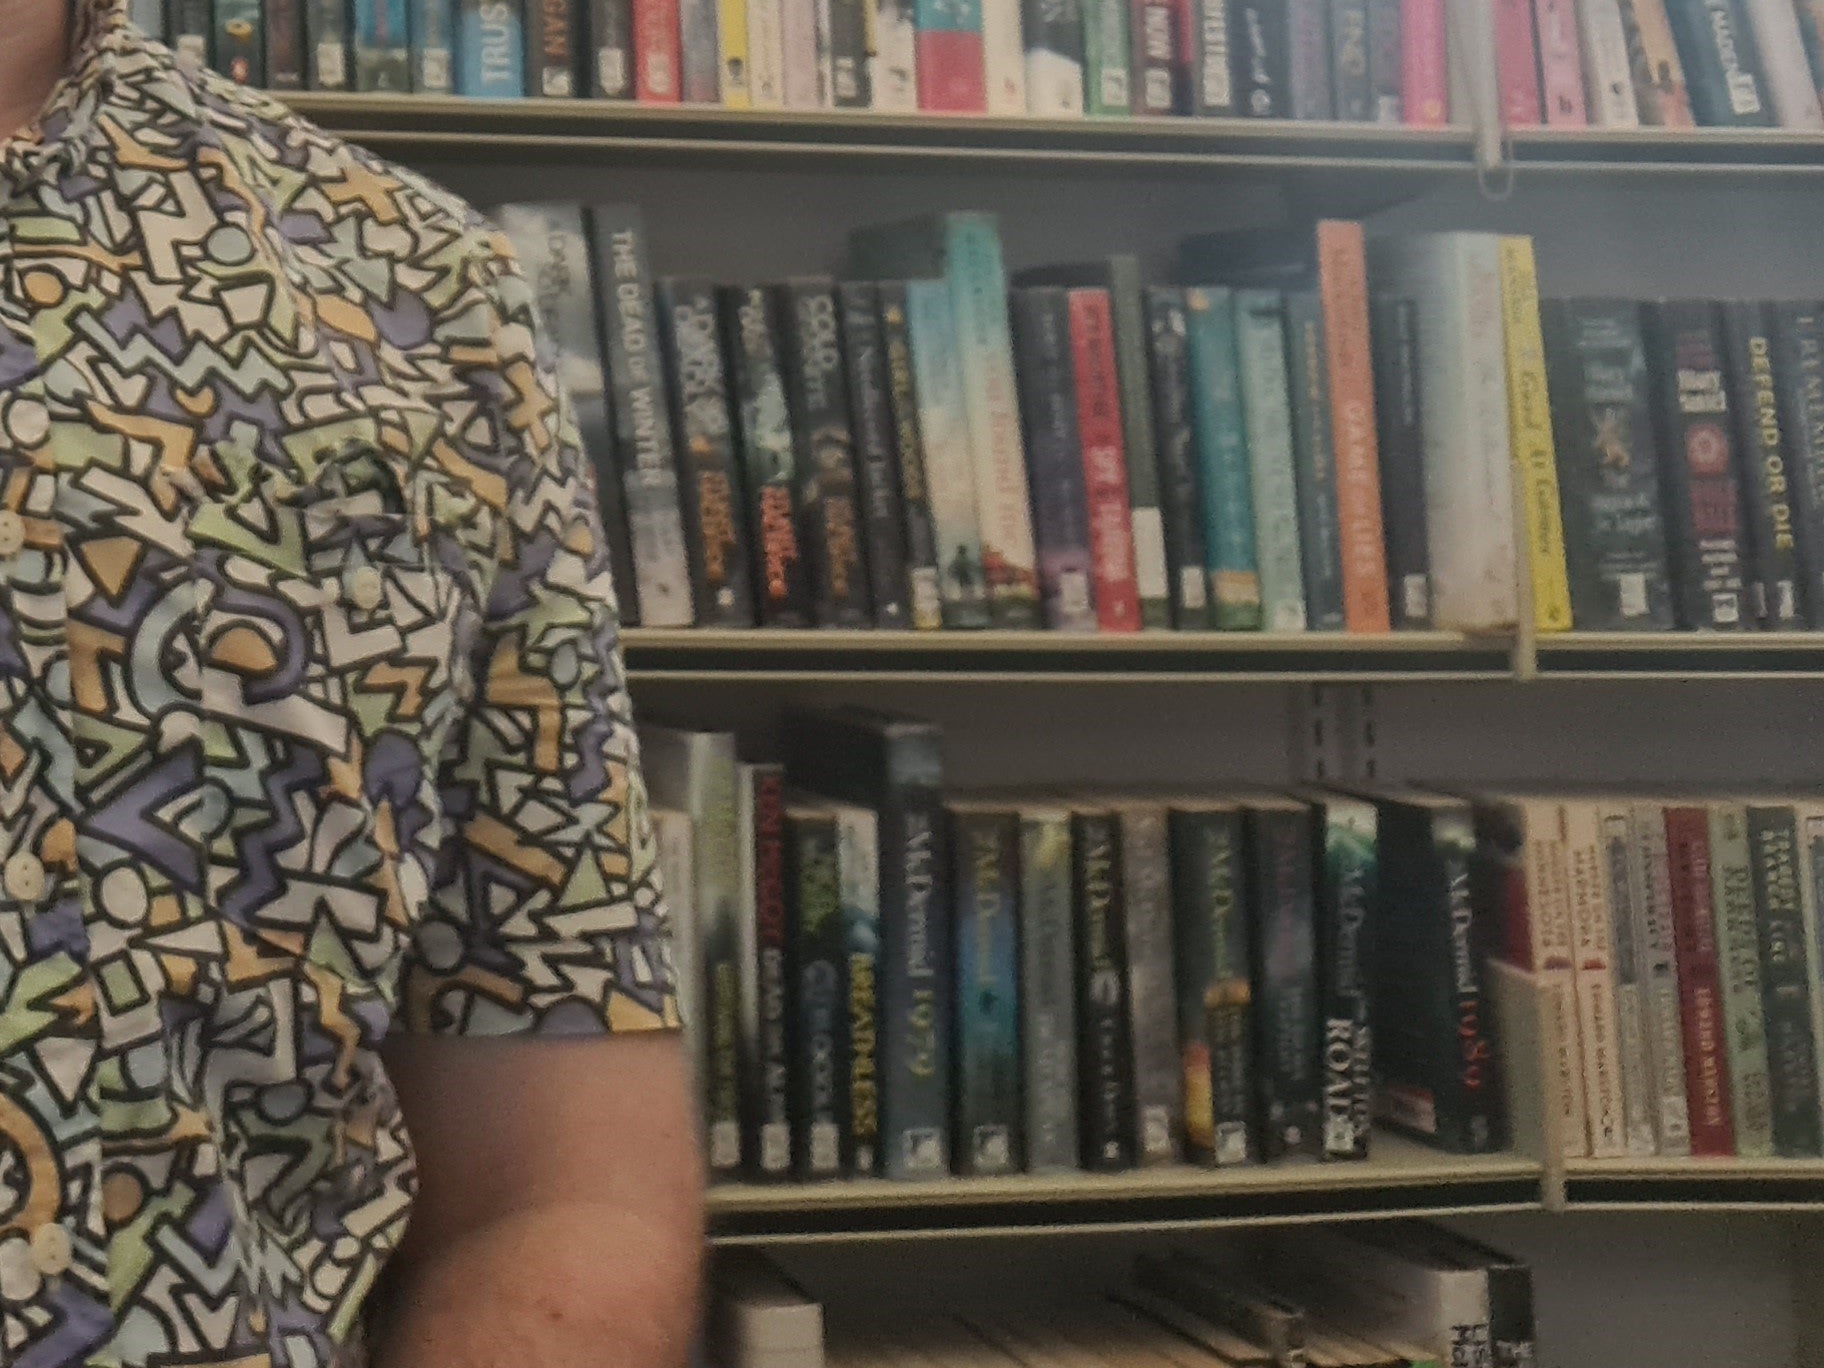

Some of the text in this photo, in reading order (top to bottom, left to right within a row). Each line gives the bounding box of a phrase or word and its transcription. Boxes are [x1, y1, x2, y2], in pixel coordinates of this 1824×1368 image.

[1144, 6, 1173, 60] NOW
[612, 229, 637, 279] THE
[616, 283, 647, 352] DEAD
[629, 386, 665, 488] WINTER
[1749, 335, 1794, 551] DEFEND OR DIE
